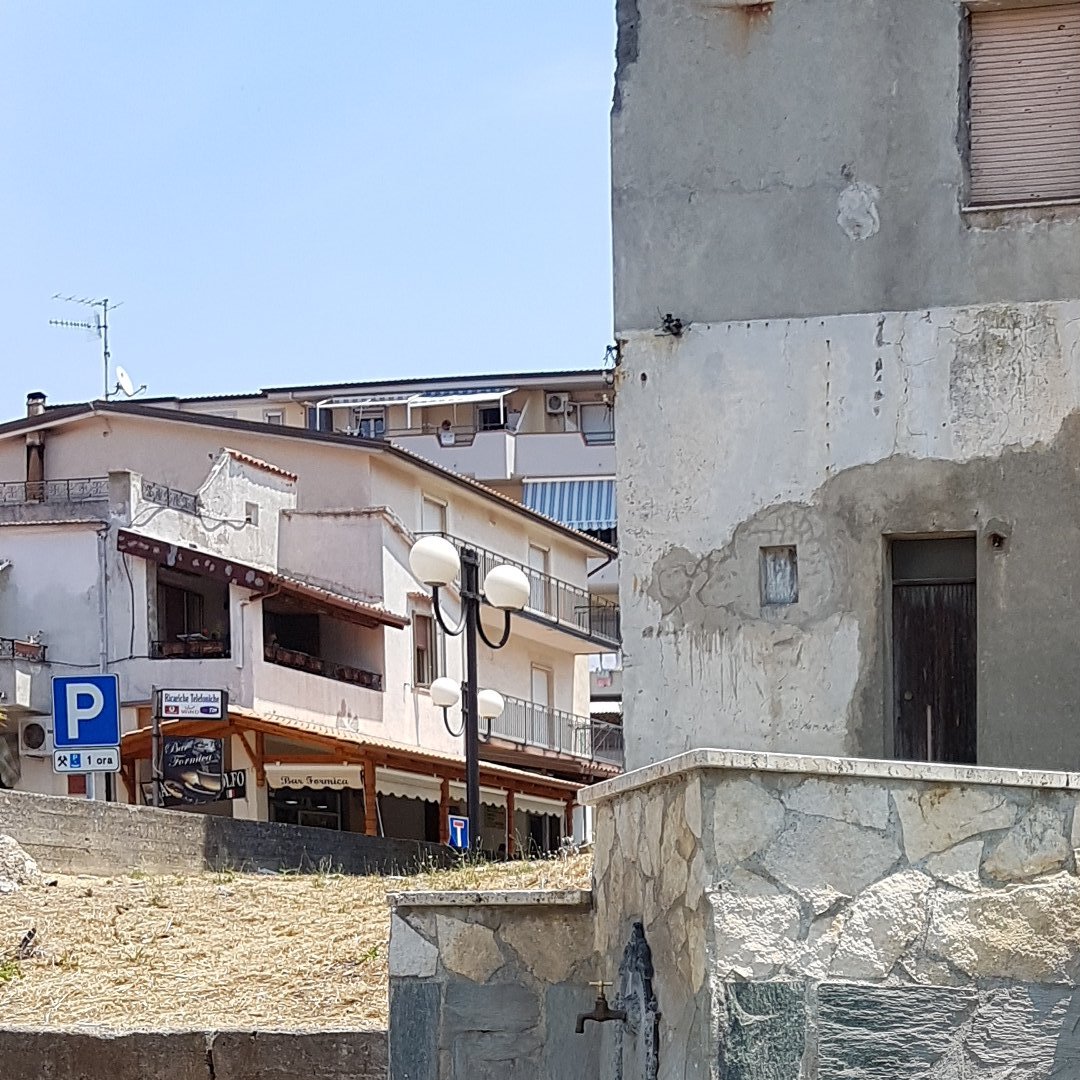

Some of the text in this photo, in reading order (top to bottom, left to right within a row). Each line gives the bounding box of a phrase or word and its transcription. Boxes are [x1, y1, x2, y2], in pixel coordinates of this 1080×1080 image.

[165, 693, 219, 703] Ricariche Telefoniche
[66, 683, 104, 739] P
[87, 755, 113, 765] 1 ora
[281, 775, 349, 785] Bar Formica
